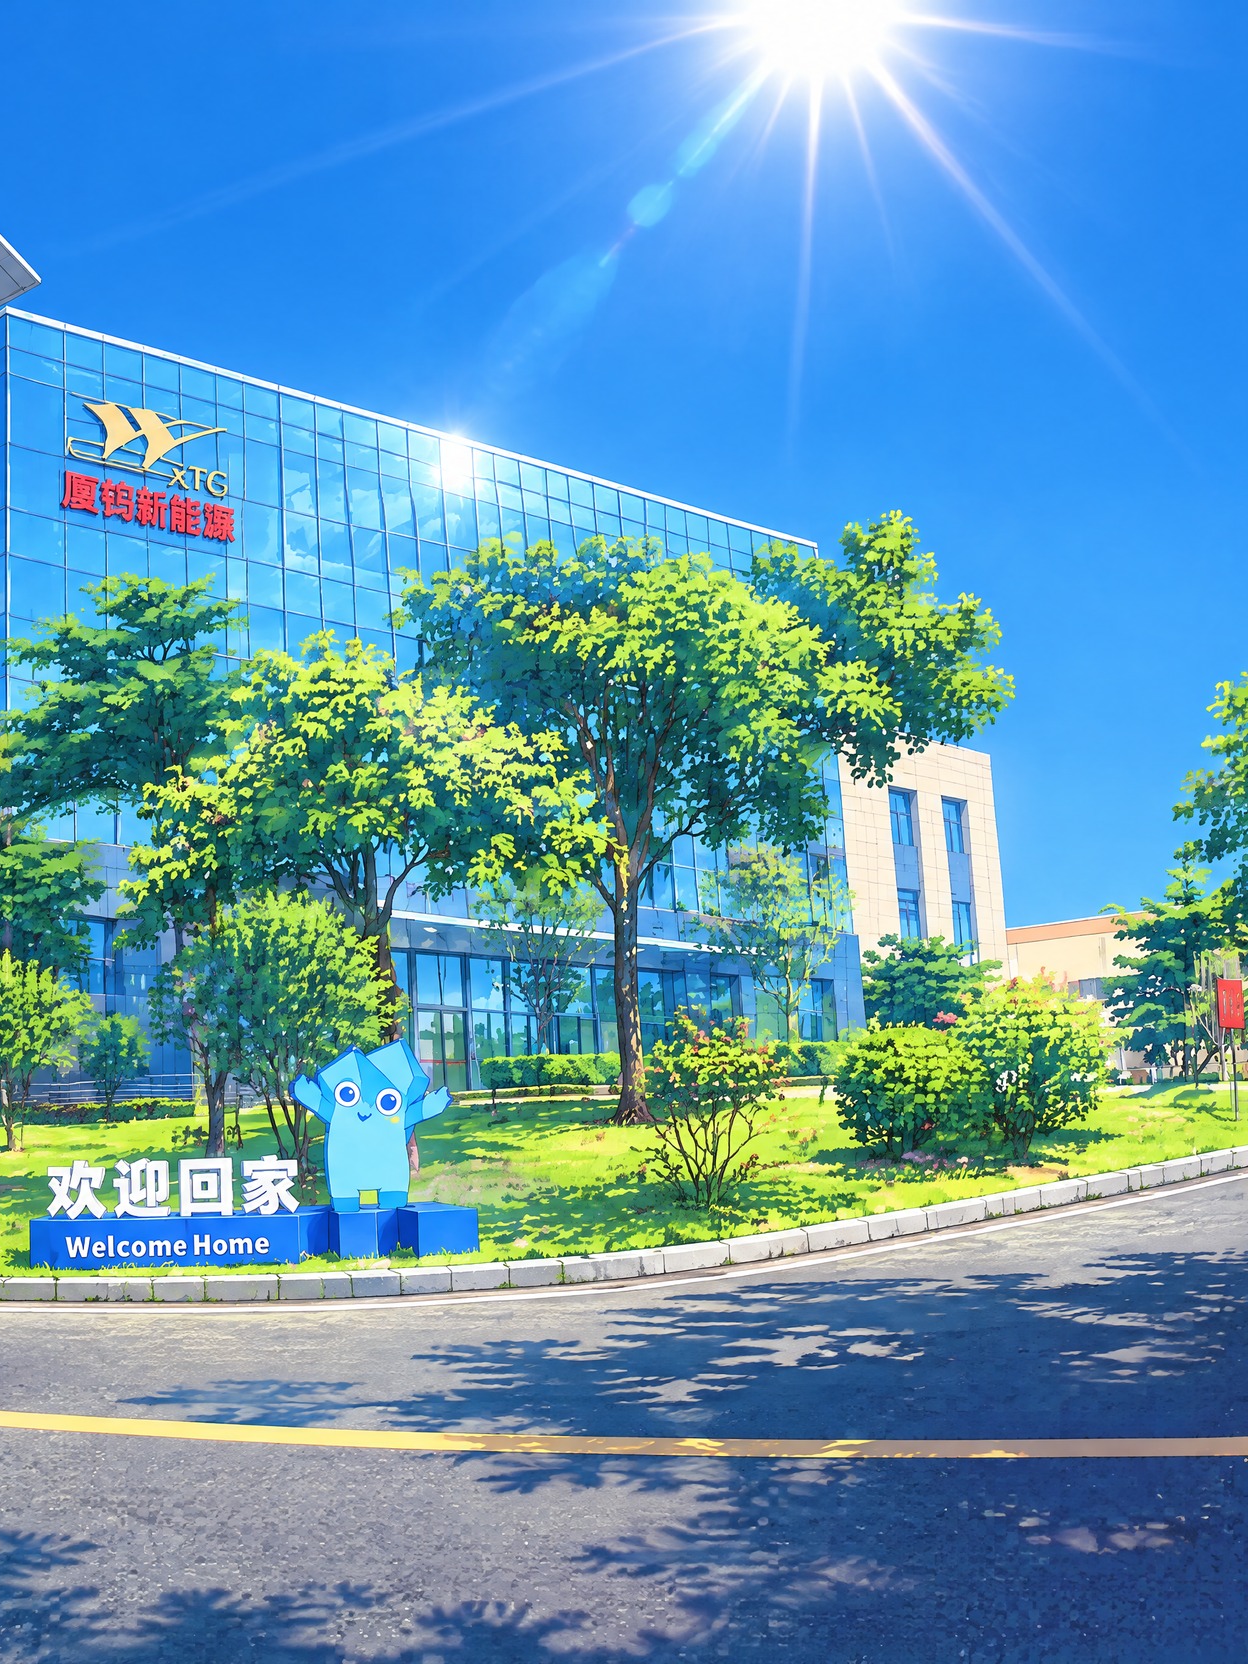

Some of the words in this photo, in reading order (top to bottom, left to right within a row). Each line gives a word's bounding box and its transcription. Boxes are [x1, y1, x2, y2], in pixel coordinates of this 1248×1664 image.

[46, 1154, 300, 1220] 欢迎回家
[65, 1235, 187, 1258] Welcome
[193, 1234, 270, 1257] Home
